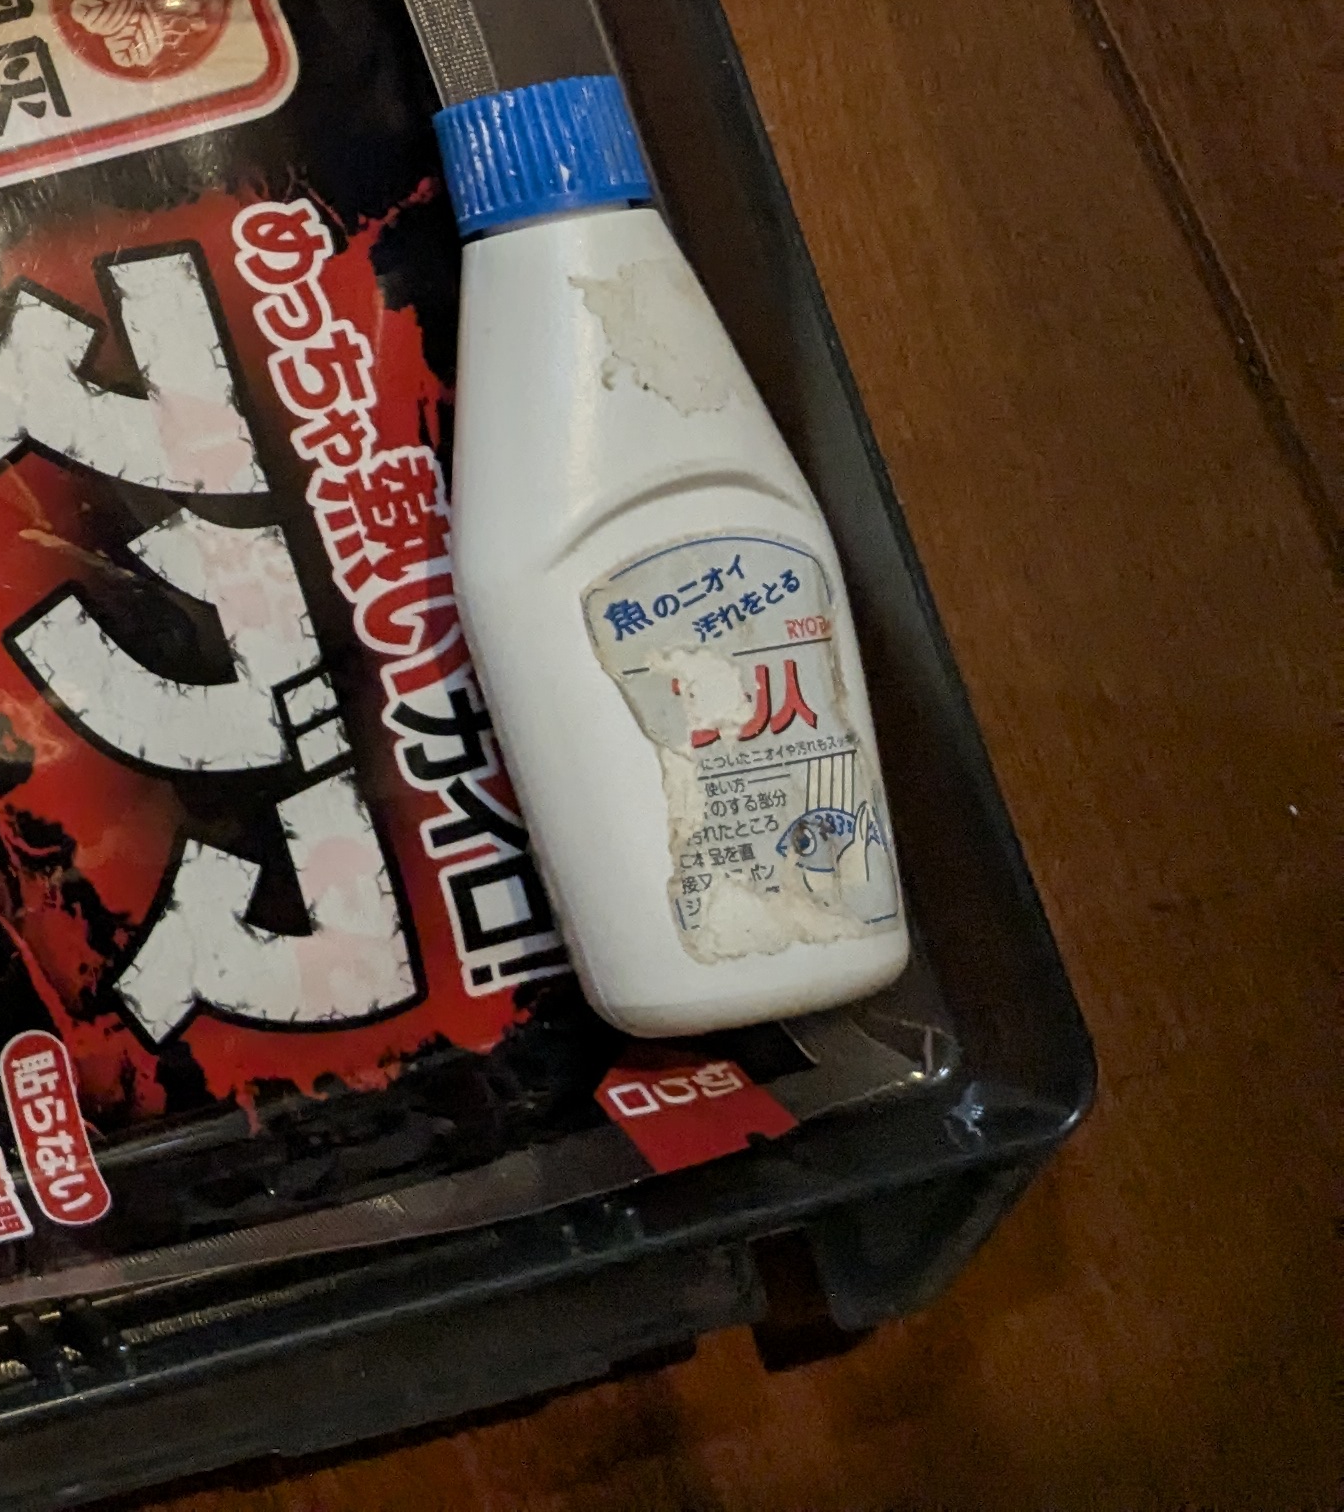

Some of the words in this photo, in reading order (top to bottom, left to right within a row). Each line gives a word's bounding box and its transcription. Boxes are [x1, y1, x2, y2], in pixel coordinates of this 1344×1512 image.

[603, 554, 747, 642] 魚のニオイ
[692, 568, 802, 644] 汚れをとる
[703, 789, 788, 821] のする部分
[10, 1049, 93, 1212] 貼らない
